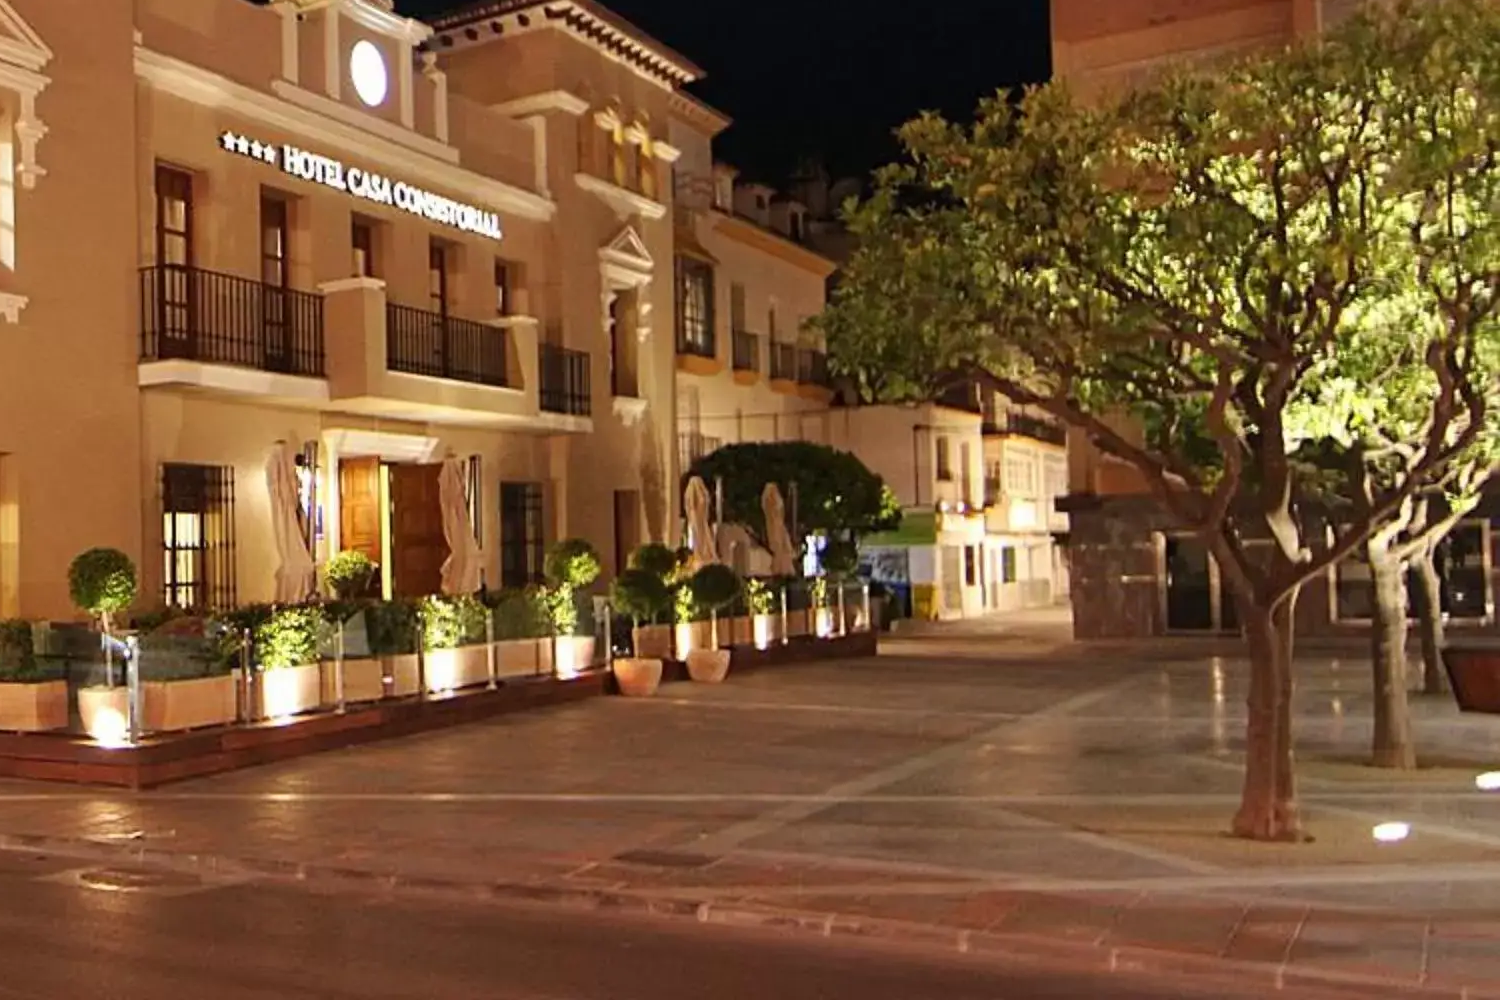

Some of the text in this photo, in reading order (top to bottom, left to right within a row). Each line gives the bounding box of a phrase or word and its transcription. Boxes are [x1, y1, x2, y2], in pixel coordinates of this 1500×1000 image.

[283, 144, 502, 239] HOTEL CASA CONSISTORIAL
